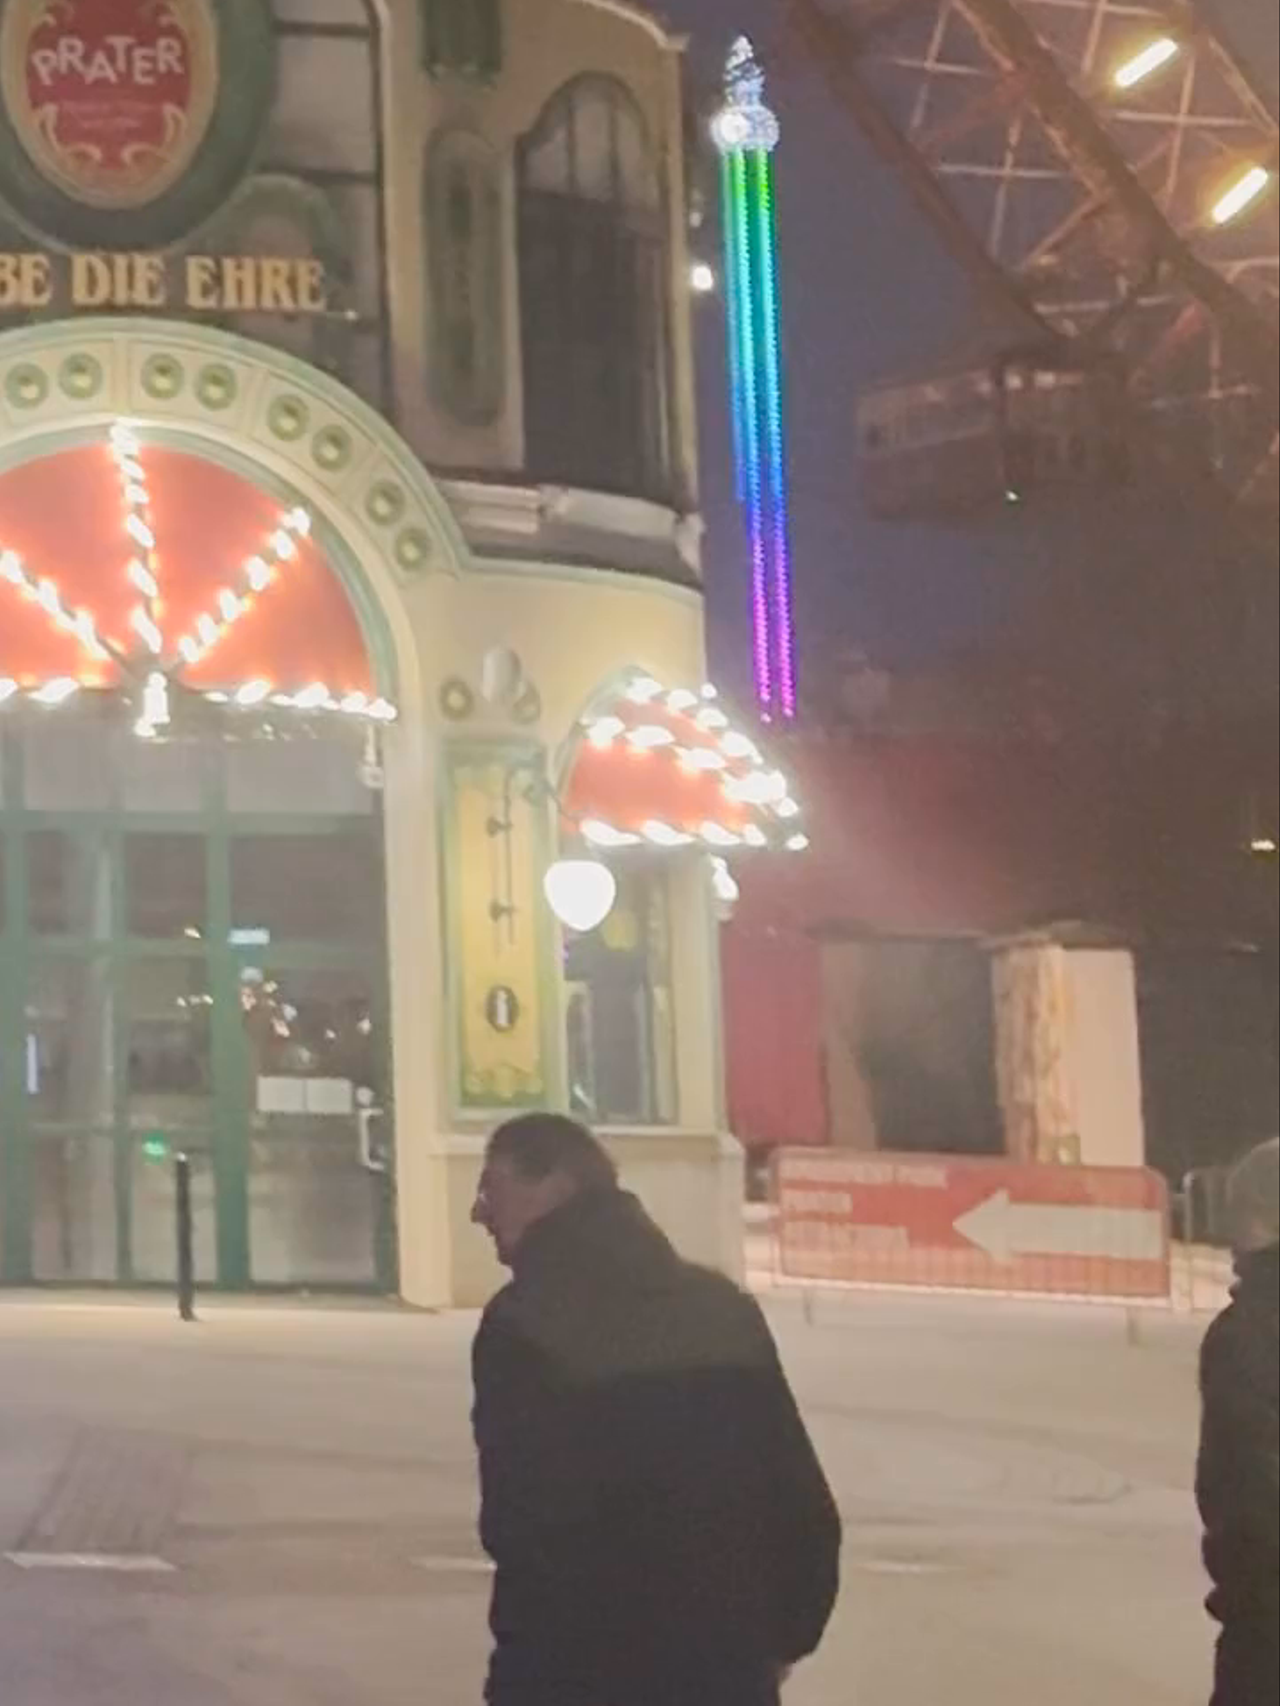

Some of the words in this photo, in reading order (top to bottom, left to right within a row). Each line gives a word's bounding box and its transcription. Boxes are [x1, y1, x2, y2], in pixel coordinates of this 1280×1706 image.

[31, 34, 185, 86] PRATER
[69, 253, 167, 307] DIE
[184, 255, 328, 312] EHRE
